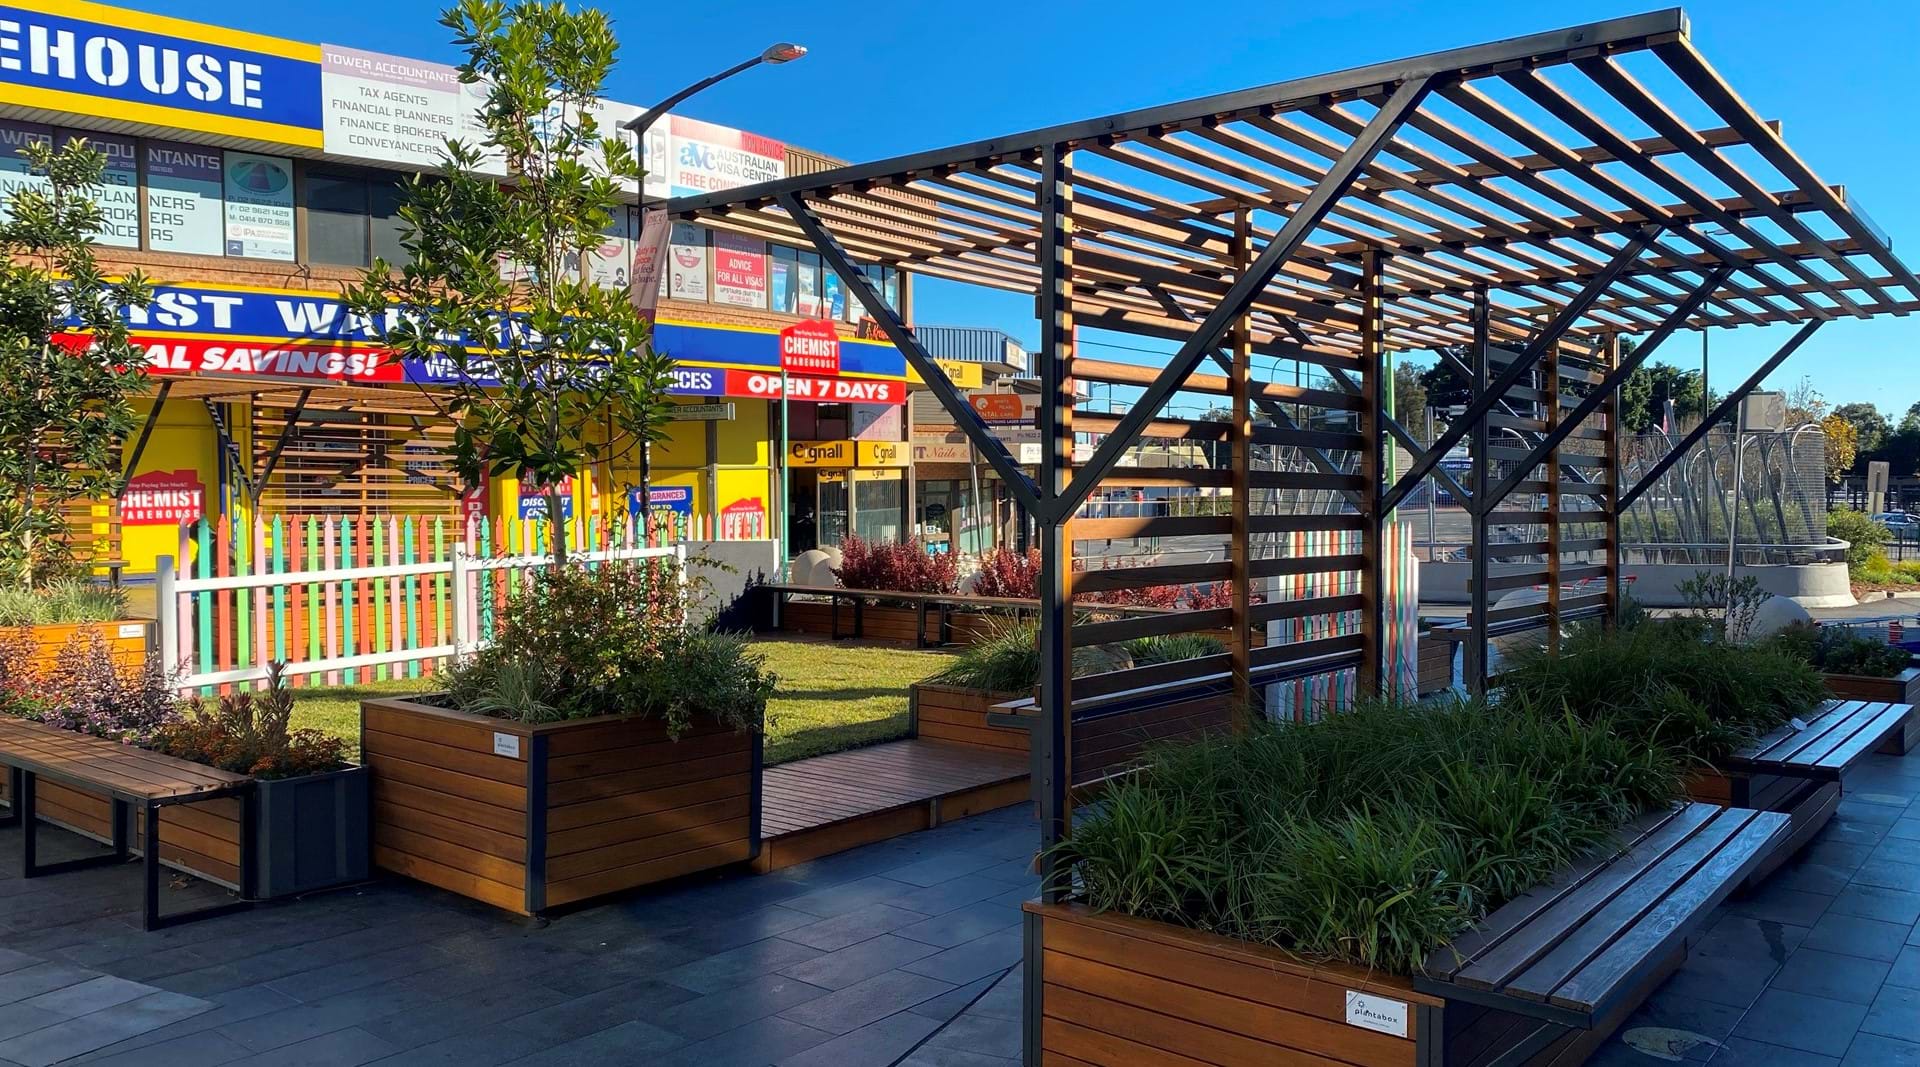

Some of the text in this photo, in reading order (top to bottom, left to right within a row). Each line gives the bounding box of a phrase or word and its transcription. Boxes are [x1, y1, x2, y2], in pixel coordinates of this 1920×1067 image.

[326, 53, 371, 71] TOWER
[375, 61, 459, 84] ACCOUNTANTS
[359, 87, 428, 106] TAX AGENTS
[332, 99, 391, 117] FINANCIAL
[395, 108, 454, 126] PLANNERS
[340, 116, 448, 140] FINANCE BROKERS
[349, 134, 440, 154] CONVEYANCERS
[715, 148, 778, 173] AUSTRALIAN
[716, 161, 740, 177] VISA
[680, 171, 706, 189] FREE
[729, 257, 752, 272] ADVICE
[718, 270, 764, 288] FOR ALL VISAS
[784, 335, 836, 358] CHEMIST
[200, 345, 379, 377] SAVINGS!
[785, 356, 835, 369] WAREHOUSE
[748, 375, 889, 401] OPEN 7 DAYS
[926, 446, 956, 459] Nails
[121, 508, 201, 520] AREHOUSE
[1354, 1006, 1398, 1024] plantabox
